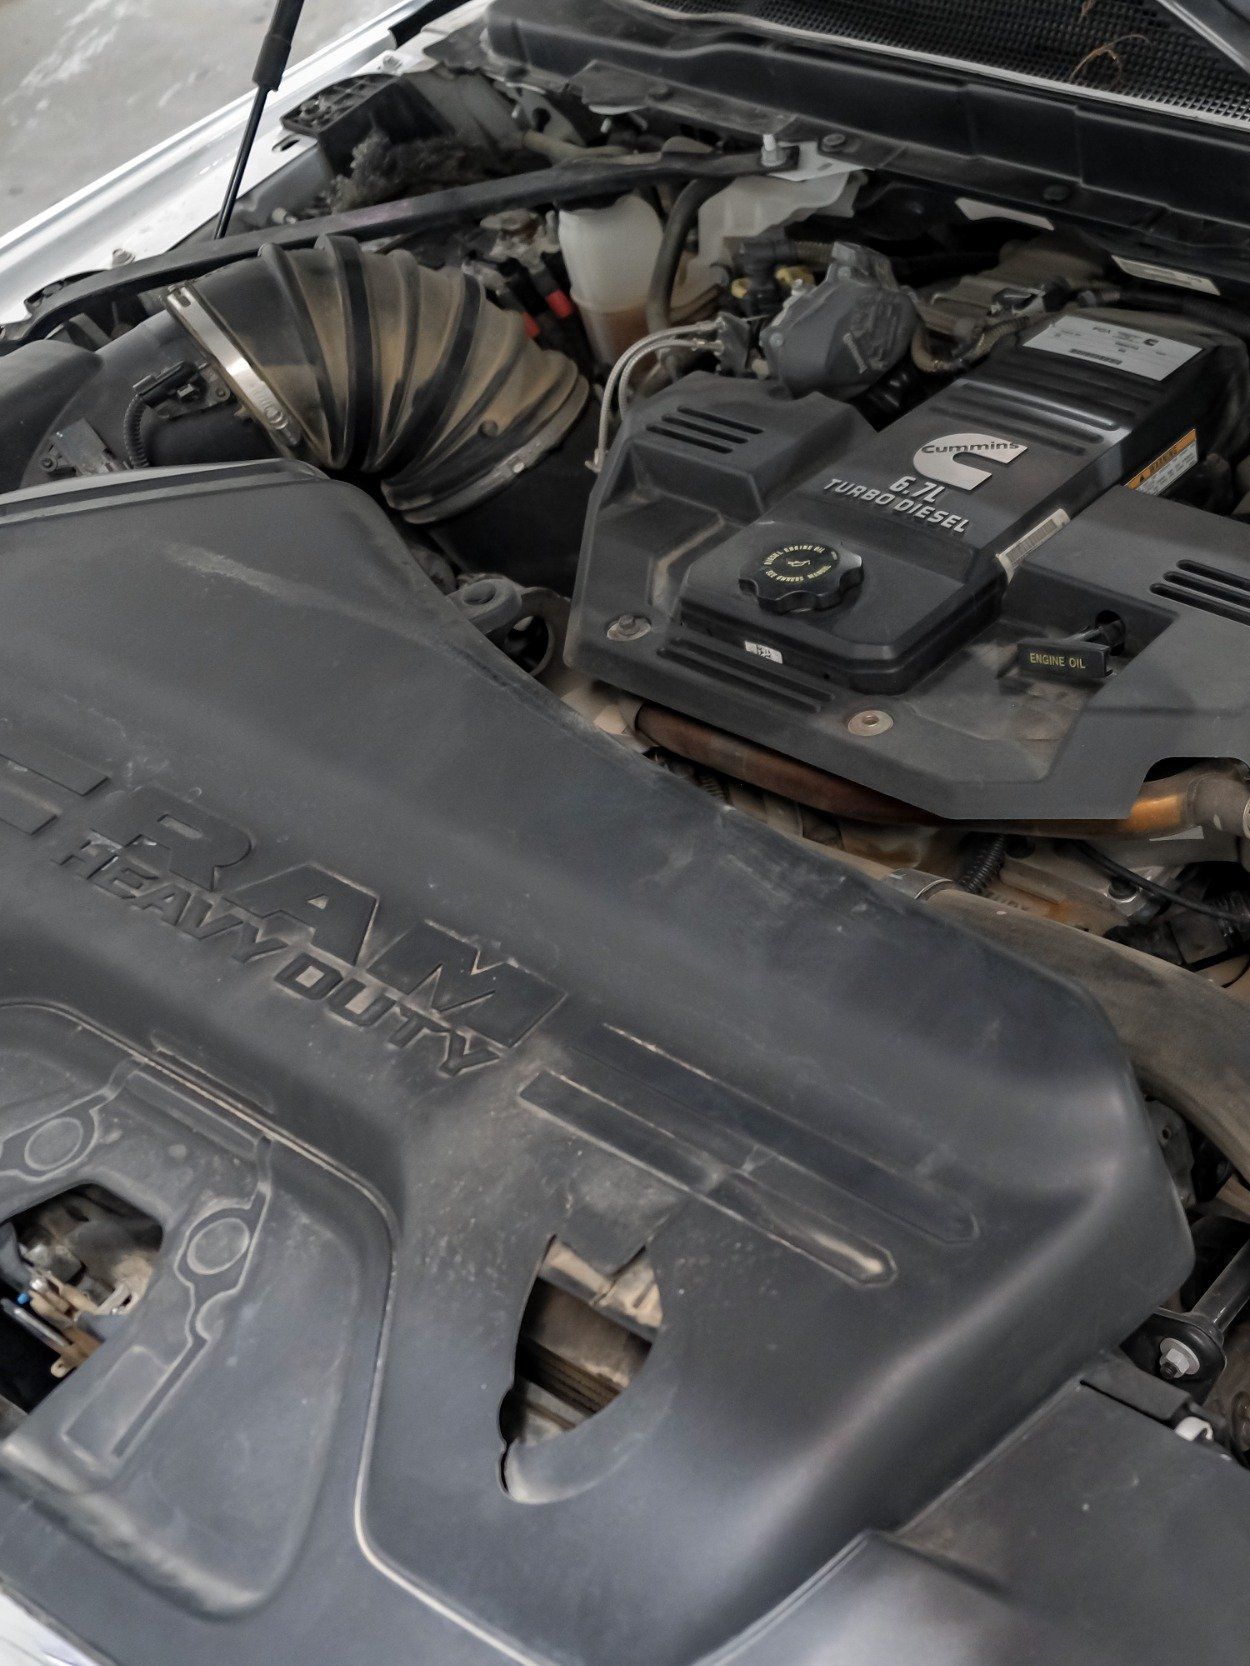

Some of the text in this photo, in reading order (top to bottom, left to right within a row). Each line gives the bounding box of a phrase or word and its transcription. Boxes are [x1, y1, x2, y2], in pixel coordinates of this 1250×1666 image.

[920, 441, 1020, 454] Cummins
[823, 478, 970, 533] TURBO DIESEL
[889, 475, 946, 503] 6.7L
[1029, 652, 1086, 669] ENGINE OIL
[91, 784, 568, 1049] RAM
[50, 839, 503, 1077] HEAVY DUTY
